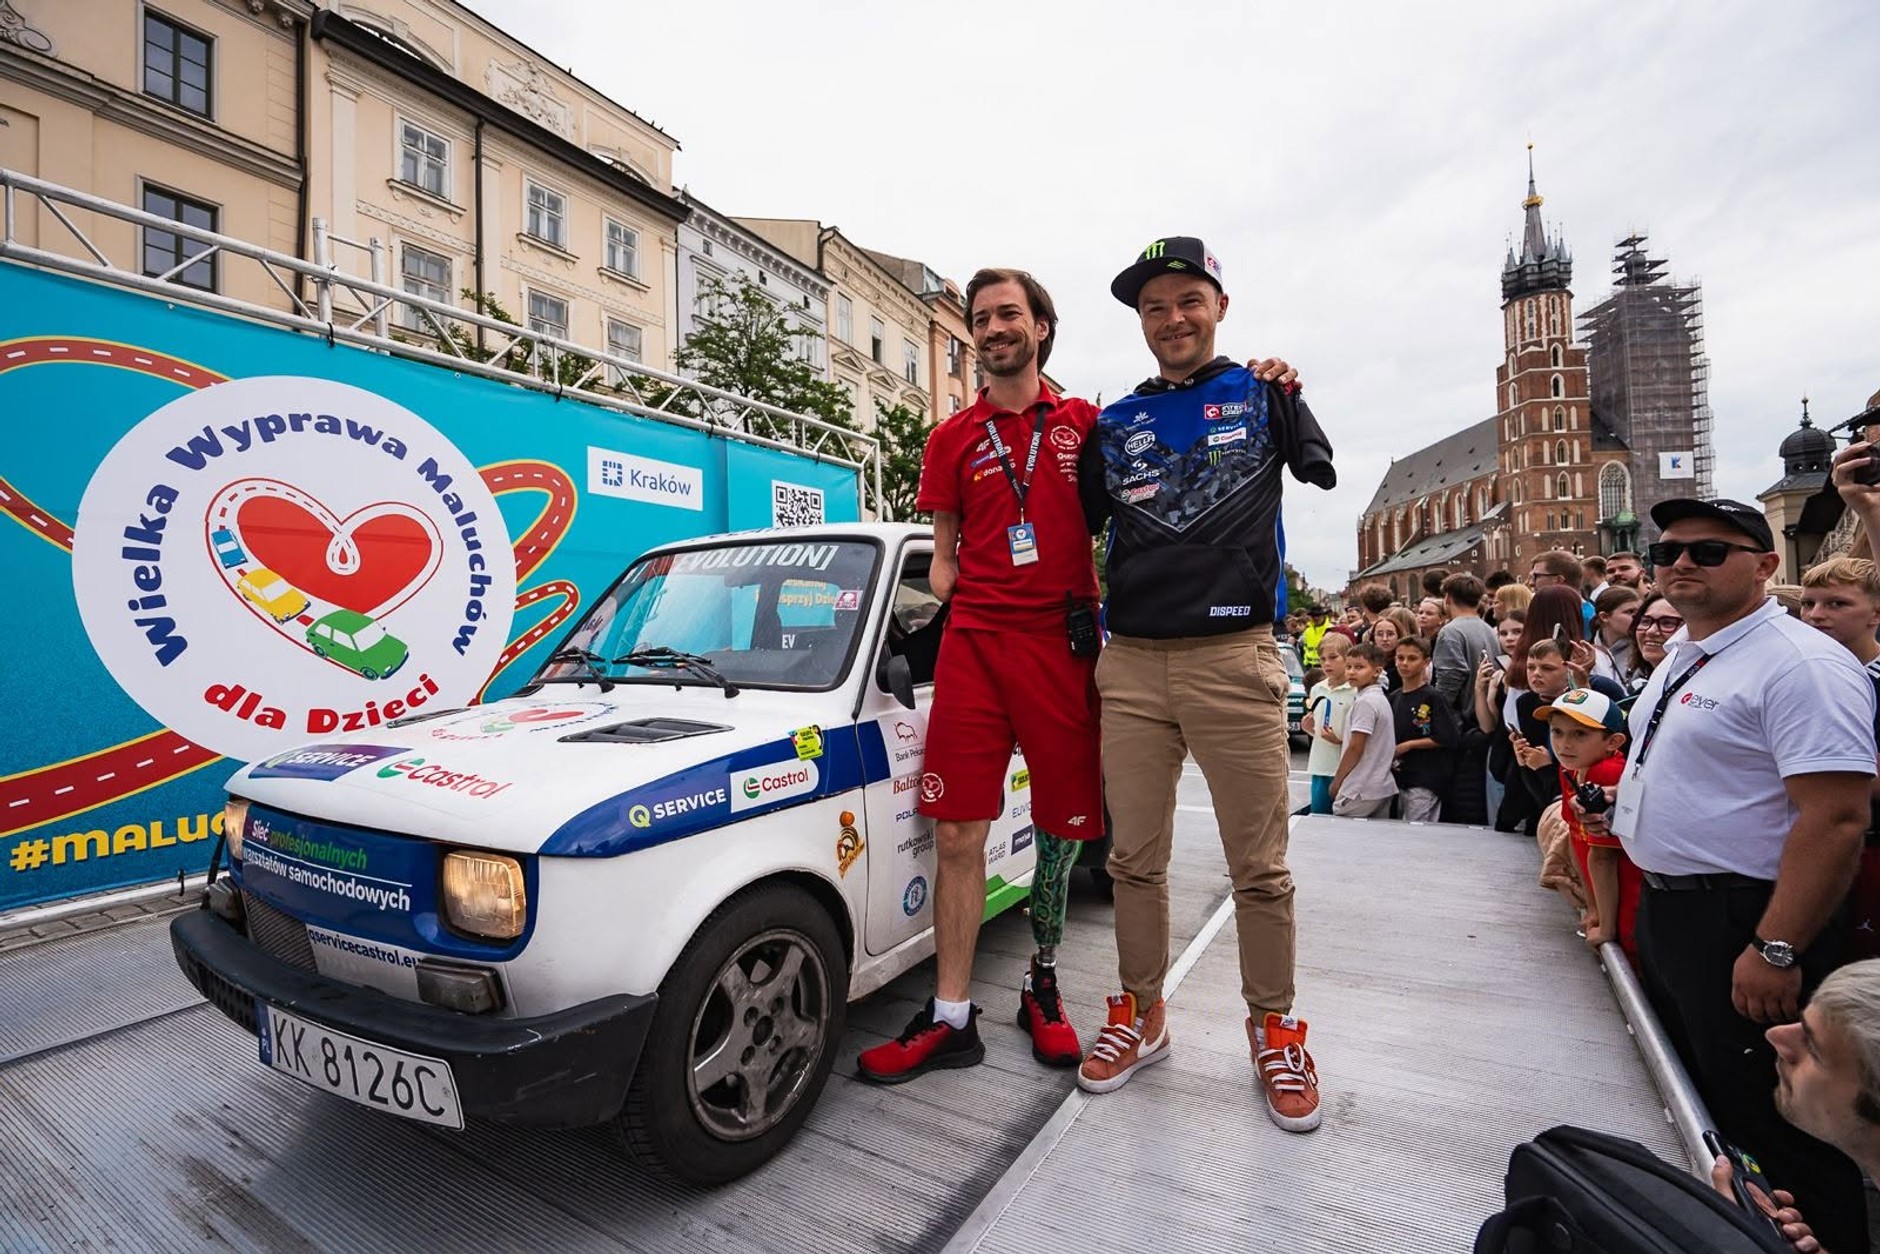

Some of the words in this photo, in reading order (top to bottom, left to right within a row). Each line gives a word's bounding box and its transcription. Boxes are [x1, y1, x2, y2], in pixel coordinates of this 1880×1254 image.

[630, 469, 692, 496] Kraków
[1122, 470, 1160, 485] SACHS
[122, 484, 188, 667] Wielka
[166, 412, 407, 471] Wyprawa
[416, 458, 493, 656] Maluchów
[1209, 606, 1251, 617] DISPEED
[782, 634, 796, 649] EV
[204, 683, 287, 730] dla
[307, 673, 440, 733] Dzieci
[407, 764, 514, 799] Castrol
[762, 767, 810, 792] Castrol
[653, 788, 727, 819] SERVICE
[1068, 815, 1087, 826] 4F
[251, 820, 270, 842] Sieć
[270, 832, 368, 870] profesjonalnych
[912, 840, 934, 859] group
[288, 864, 411, 911] samochodowych
[273, 1013, 312, 1078] KK
[321, 1036, 446, 1117] 8126C
